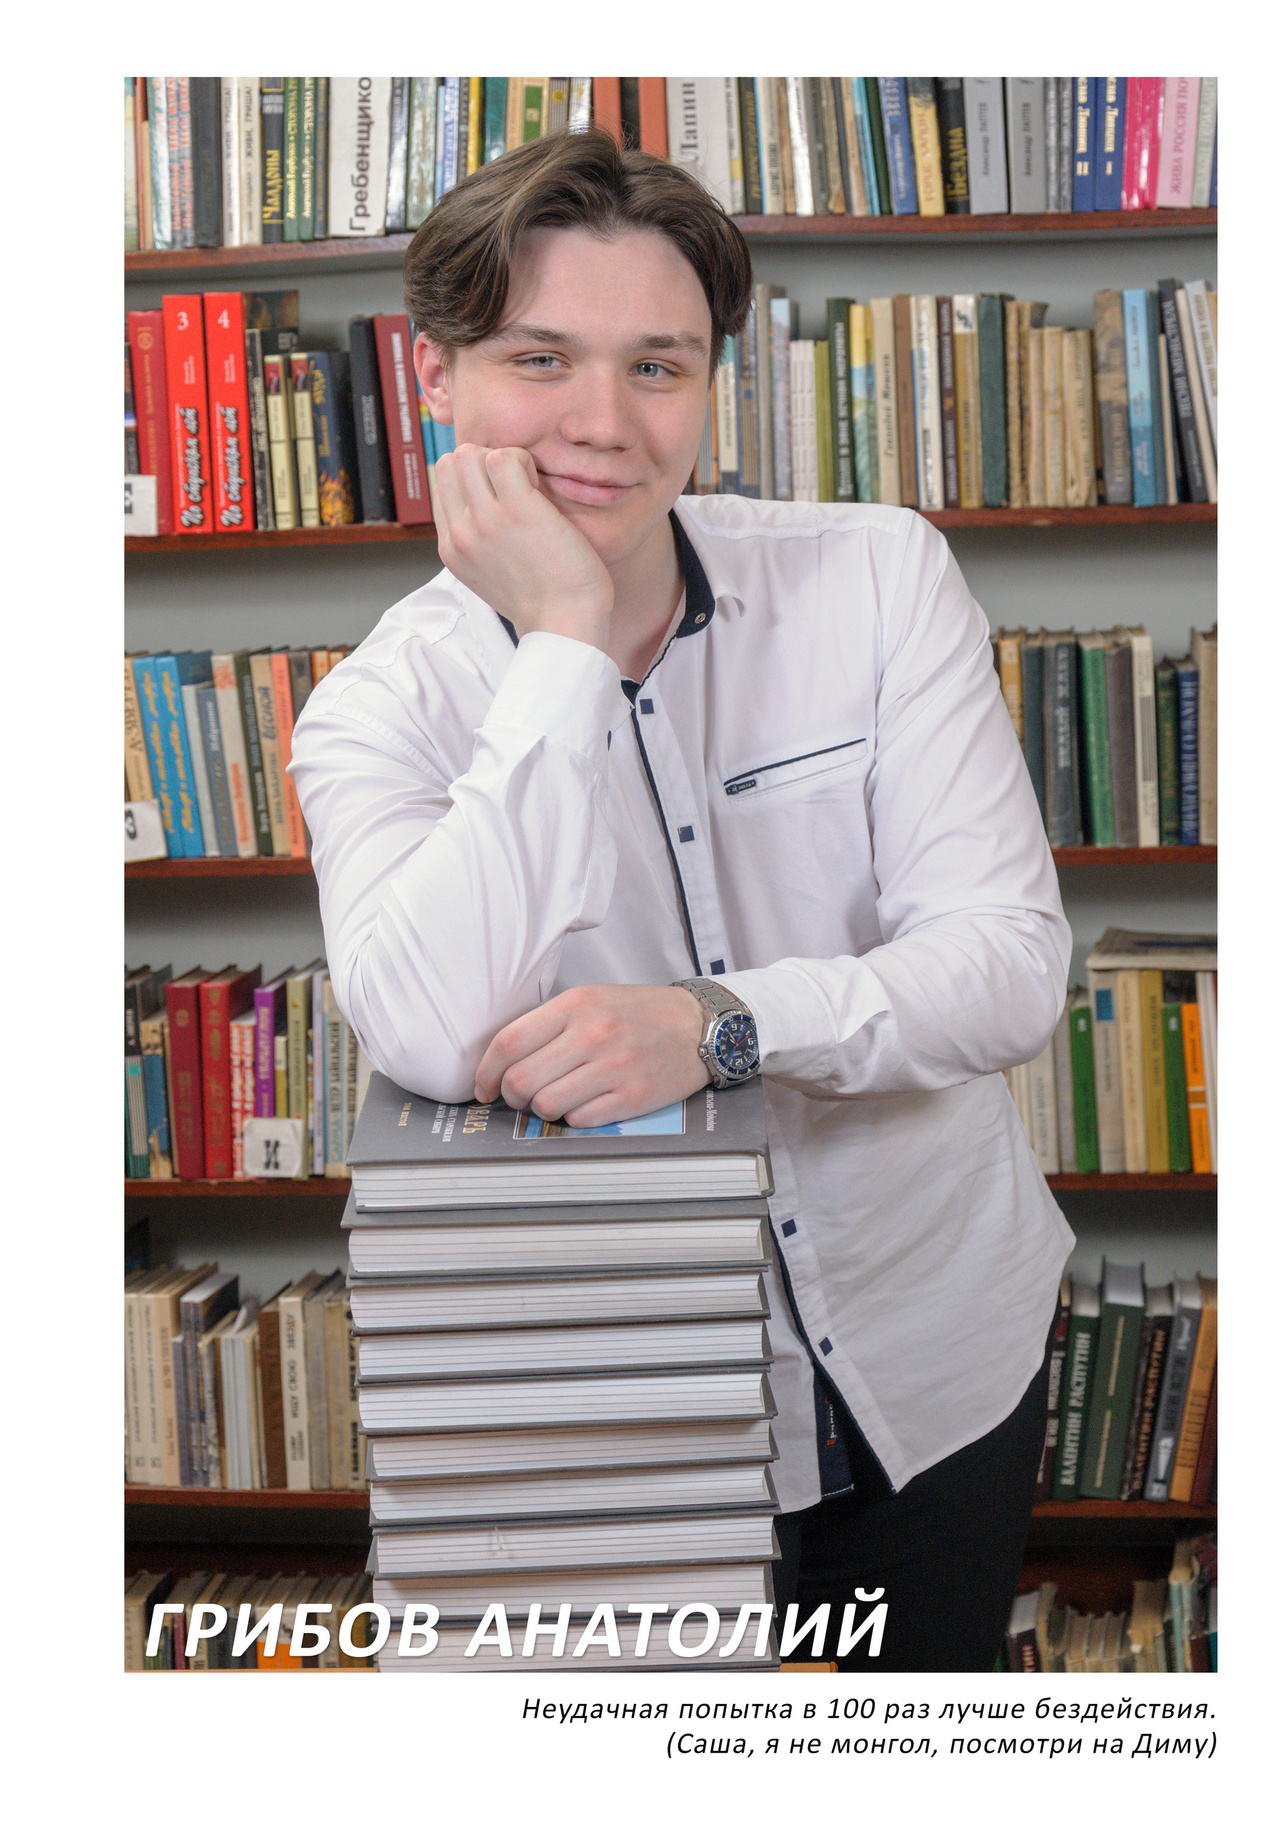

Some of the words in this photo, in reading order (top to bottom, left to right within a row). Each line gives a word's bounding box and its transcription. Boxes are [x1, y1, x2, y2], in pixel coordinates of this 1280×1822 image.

[245, 86, 254, 122] ГРИША!
[679, 83, 699, 162] Лапин
[1172, 102, 1188, 146] РОССИЯ
[946, 127, 968, 196] Бездна
[262, 149, 283, 220] Чалдоны
[177, 311, 189, 331] 3
[217, 310, 231, 329] 4
[179, 407, 199, 435] лет
[219, 406, 238, 434] лет
[180, 505, 204, 527] По
[220, 505, 243, 527] По
[263, 1140, 280, 1170] И
[287, 1314, 297, 1350] ЗВЕЗДУ
[288, 1360, 298, 1391] СВОЮ
[1067, 1331, 1092, 1407] РАСПУТИН
[290, 1396, 299, 1419] ИЩУ
[1060, 1411, 1082, 1486] ВАЛЕНТИН
